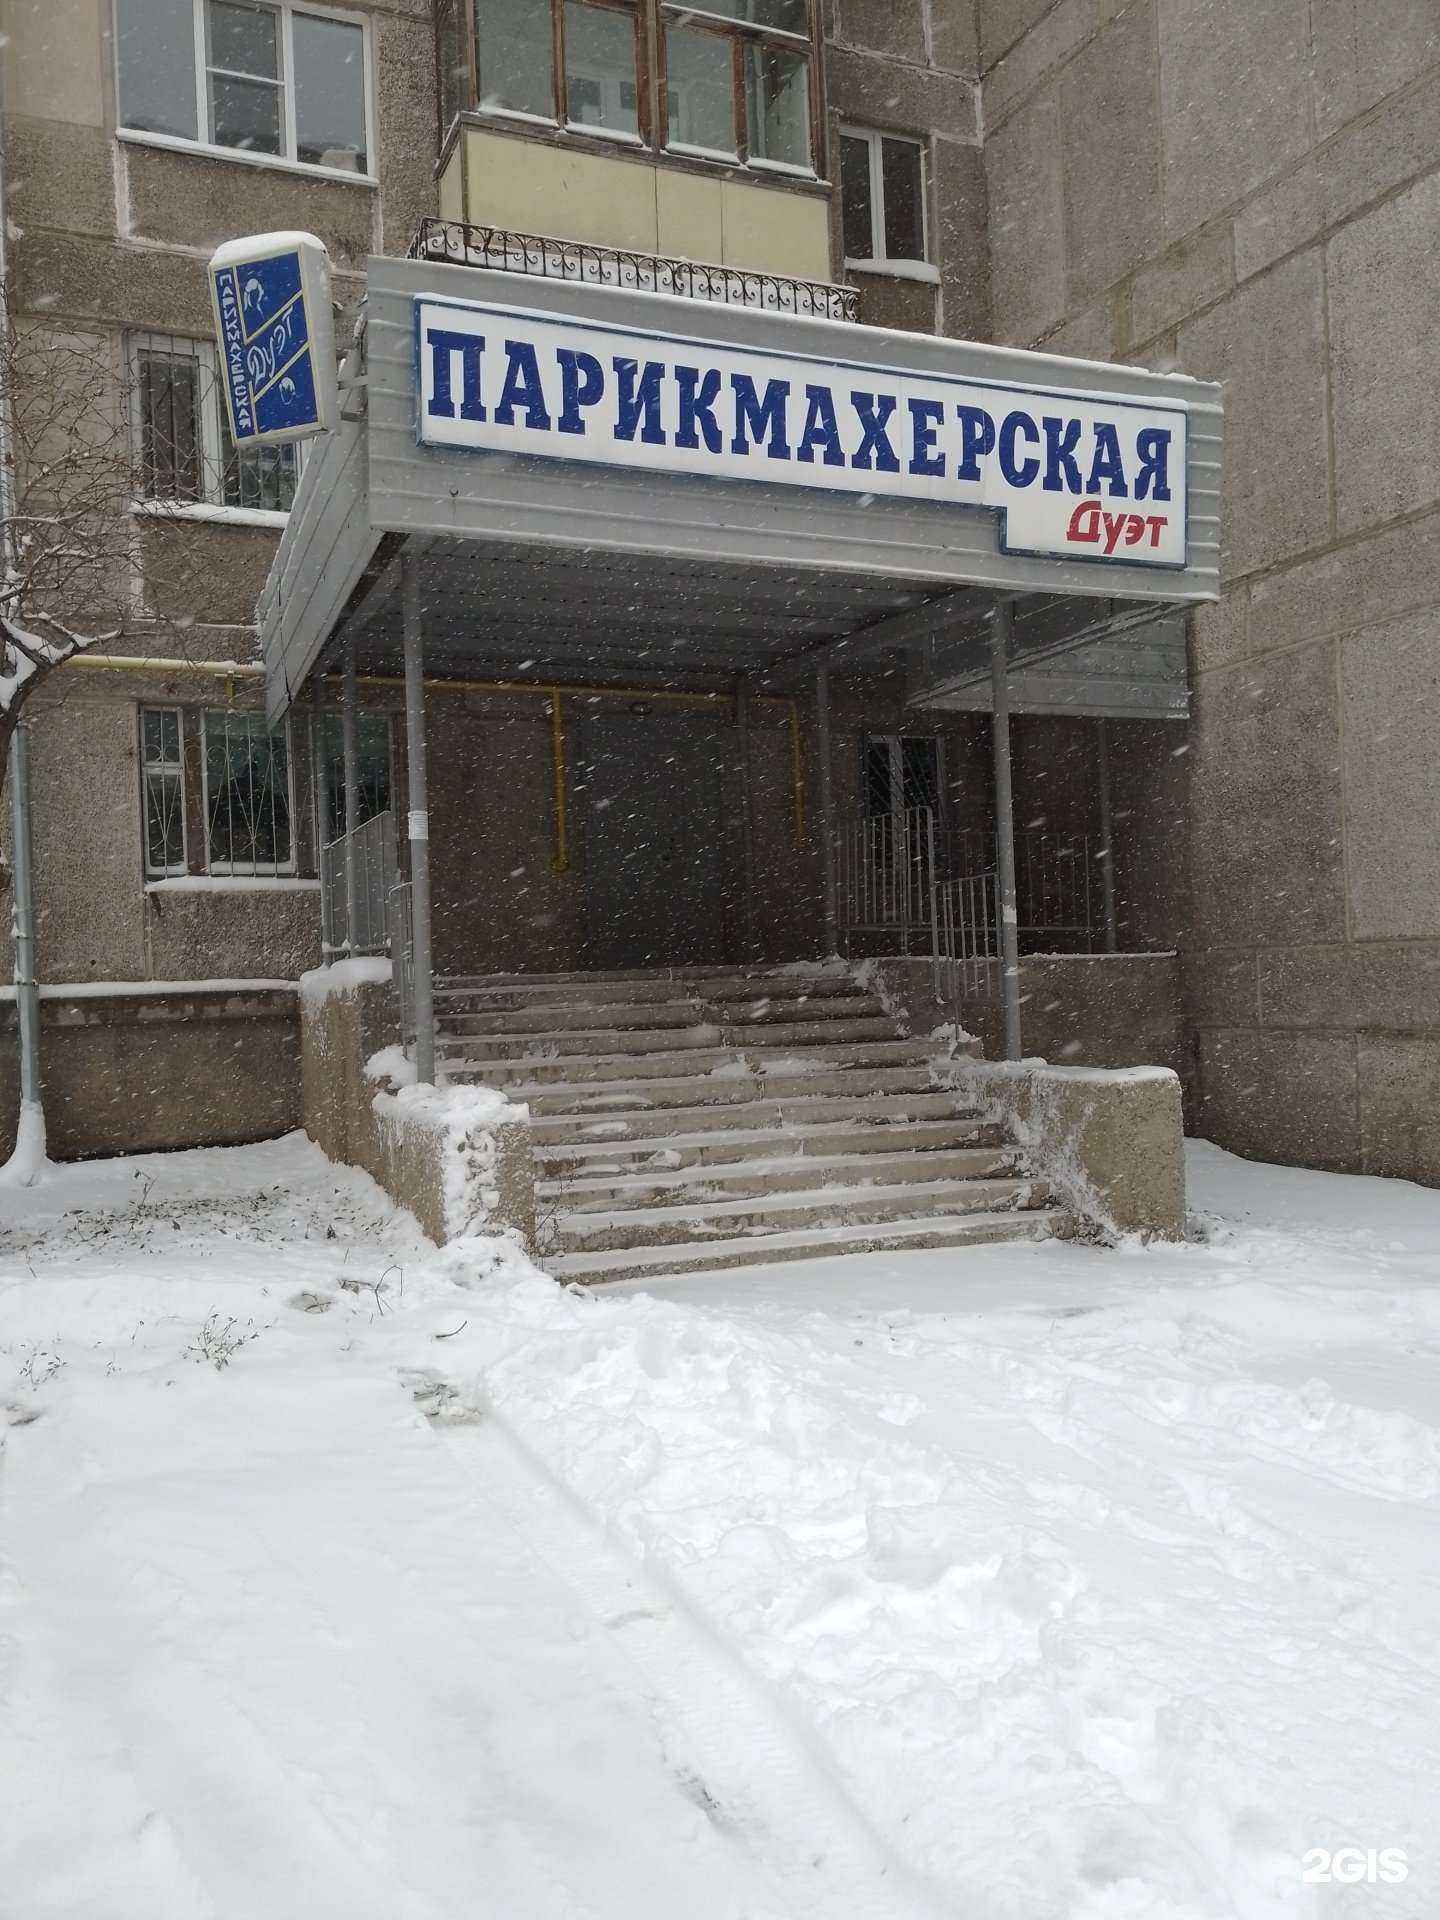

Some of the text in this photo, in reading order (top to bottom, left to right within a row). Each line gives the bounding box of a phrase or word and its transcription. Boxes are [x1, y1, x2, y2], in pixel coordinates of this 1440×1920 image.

[219, 273, 252, 428] ПАРИКМАХЕРСКАЯ
[427, 328, 1172, 501] ПАРИКМАХЕРСКАЯ
[1066, 500, 1168, 555] Дуэт
